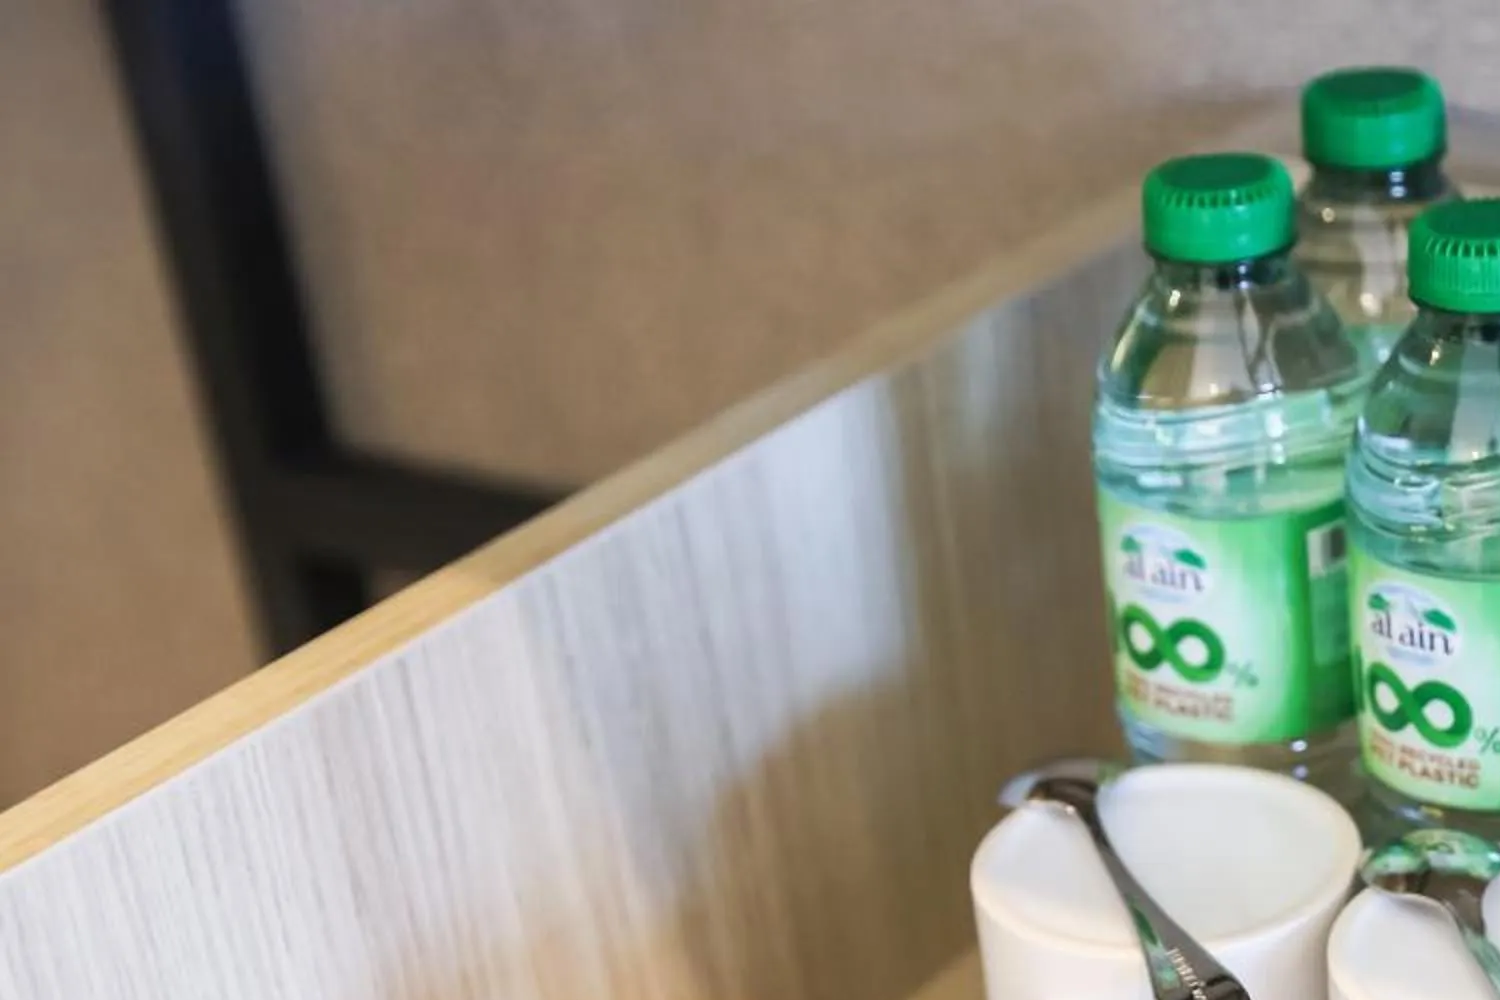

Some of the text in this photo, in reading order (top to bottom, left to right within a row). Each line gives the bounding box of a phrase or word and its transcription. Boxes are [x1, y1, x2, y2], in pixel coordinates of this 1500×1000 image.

[1370, 610, 1454, 657] al ain
[1398, 758, 1480, 790] PLASTIC
